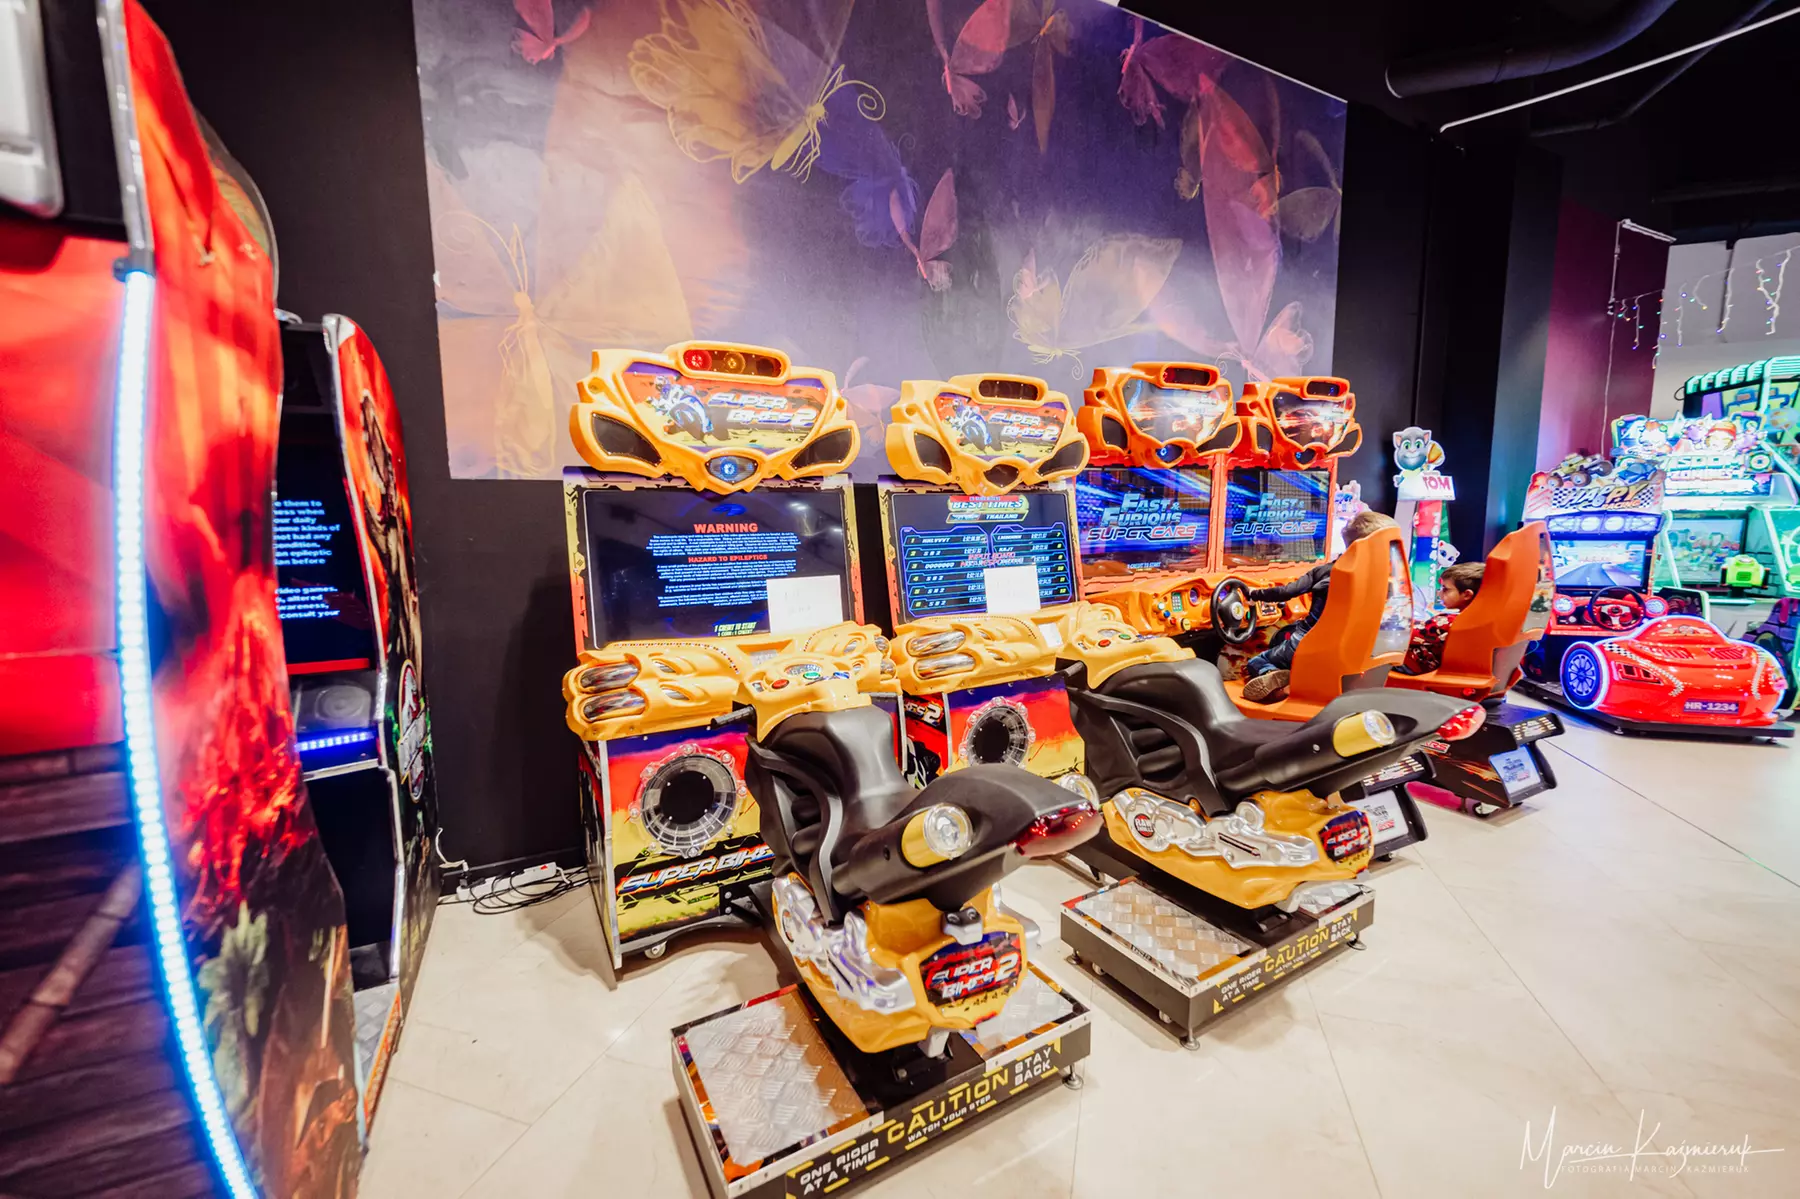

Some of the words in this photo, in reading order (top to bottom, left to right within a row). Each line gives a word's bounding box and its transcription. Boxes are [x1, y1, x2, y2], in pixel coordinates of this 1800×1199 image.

[708, 392, 788, 410] SUPER
[726, 409, 794, 424] BIKES
[791, 408, 818, 427] 2
[988, 412, 1041, 426] SUPER
[1000, 425, 1045, 439] BIKES
[1042, 426, 1060, 440] 2
[1423, 476, 1451, 490] TOM
[1260, 493, 1299, 509] FAST
[1560, 480, 1649, 508] HAPPY
[1121, 493, 1171, 513] FAST
[1170, 501, 1180, 511] &
[292, 516, 317, 525] daily
[1101, 507, 1182, 526] FURIOUS
[1244, 505, 1307, 522] FURIOUS
[301, 524, 328, 532] kinds
[693, 523, 759, 534] WARNING
[1086, 525, 1198, 542] SUPERCARS
[1232, 521, 1318, 536] SUPERCARS
[313, 533, 332, 541] any
[290, 549, 333, 558] epileptic
[730, 554, 768, 562] EPILEPTICS
[287, 594, 323, 603] altered
[302, 586, 338, 594] games.
[278, 610, 317, 619] consult
[317, 610, 341, 618] your
[1684, 701, 1738, 711] HR-1234
[924, 703, 944, 727] 2
[1327, 828, 1358, 844] SUPER
[1359, 826, 1369, 844] 2
[618, 857, 718, 895] SUPER
[1331, 916, 1353, 933] STAY
[1330, 925, 1352, 942] BACK
[1264, 928, 1329, 973] CAUTION
[931, 956, 994, 985] SUPER
[942, 971, 996, 998] BIKES
[995, 952, 1019, 982] 2
[1221, 981, 1238, 995] ONE
[1239, 967, 1262, 984] RIDER
[1222, 992, 1233, 1002] AT
[1234, 987, 1240, 996] A
[1242, 976, 1260, 990] TIME
[1015, 1046, 1052, 1073] STAY
[1014, 1060, 1051, 1087] BACK
[887, 1068, 1009, 1145] CAUTION
[907, 1121, 941, 1143] WATCH
[942, 1108, 967, 1123] YOUR
[969, 1094, 991, 1111] STEP
[800, 1161, 832, 1186] ONE
[836, 1138, 879, 1167] RIDER
[804, 1177, 823, 1196] AT
[827, 1170, 838, 1183] A
[842, 1150, 876, 1174] TIME
